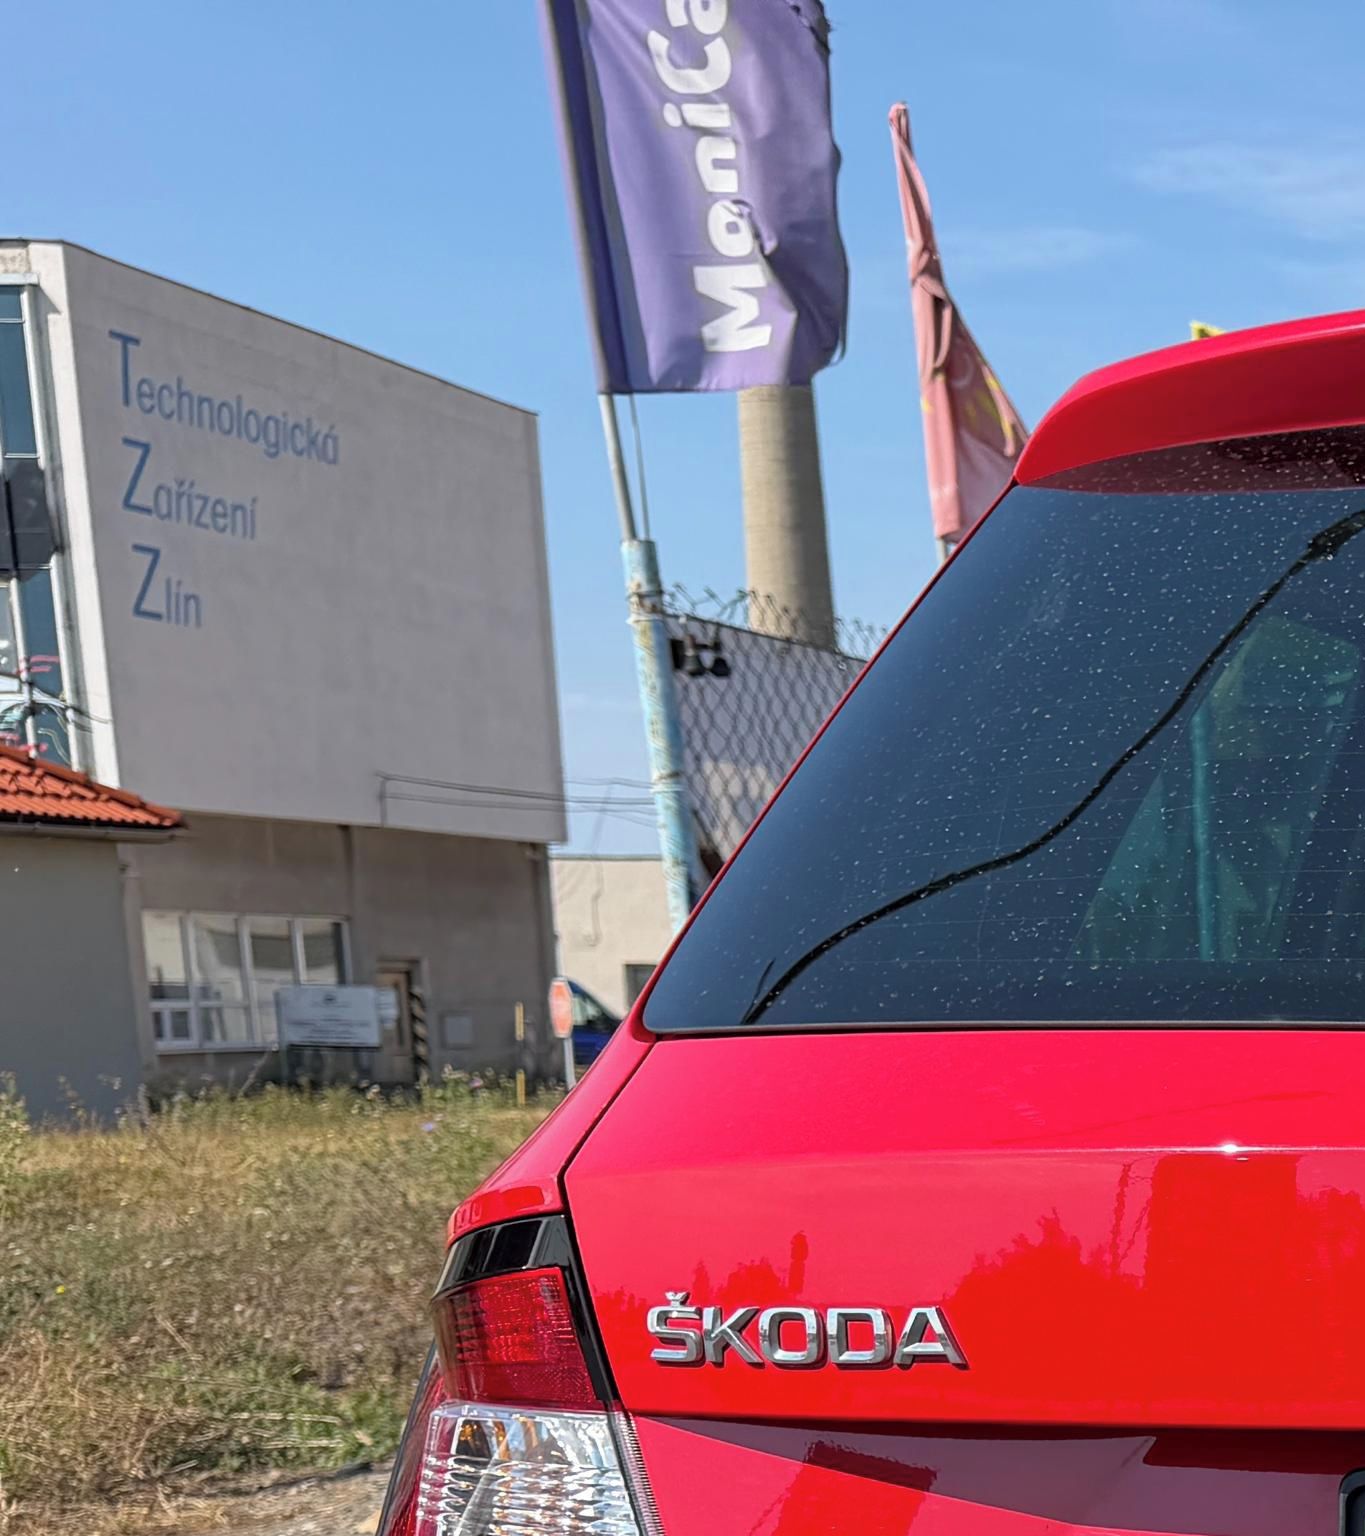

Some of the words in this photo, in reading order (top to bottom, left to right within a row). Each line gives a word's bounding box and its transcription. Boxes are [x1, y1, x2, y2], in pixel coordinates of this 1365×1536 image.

[108, 329, 339, 465] Technologická
[121, 436, 258, 540] Zařízení
[131, 544, 201, 628] Zlín
[647, 1291, 968, 1368] ŠKODA
